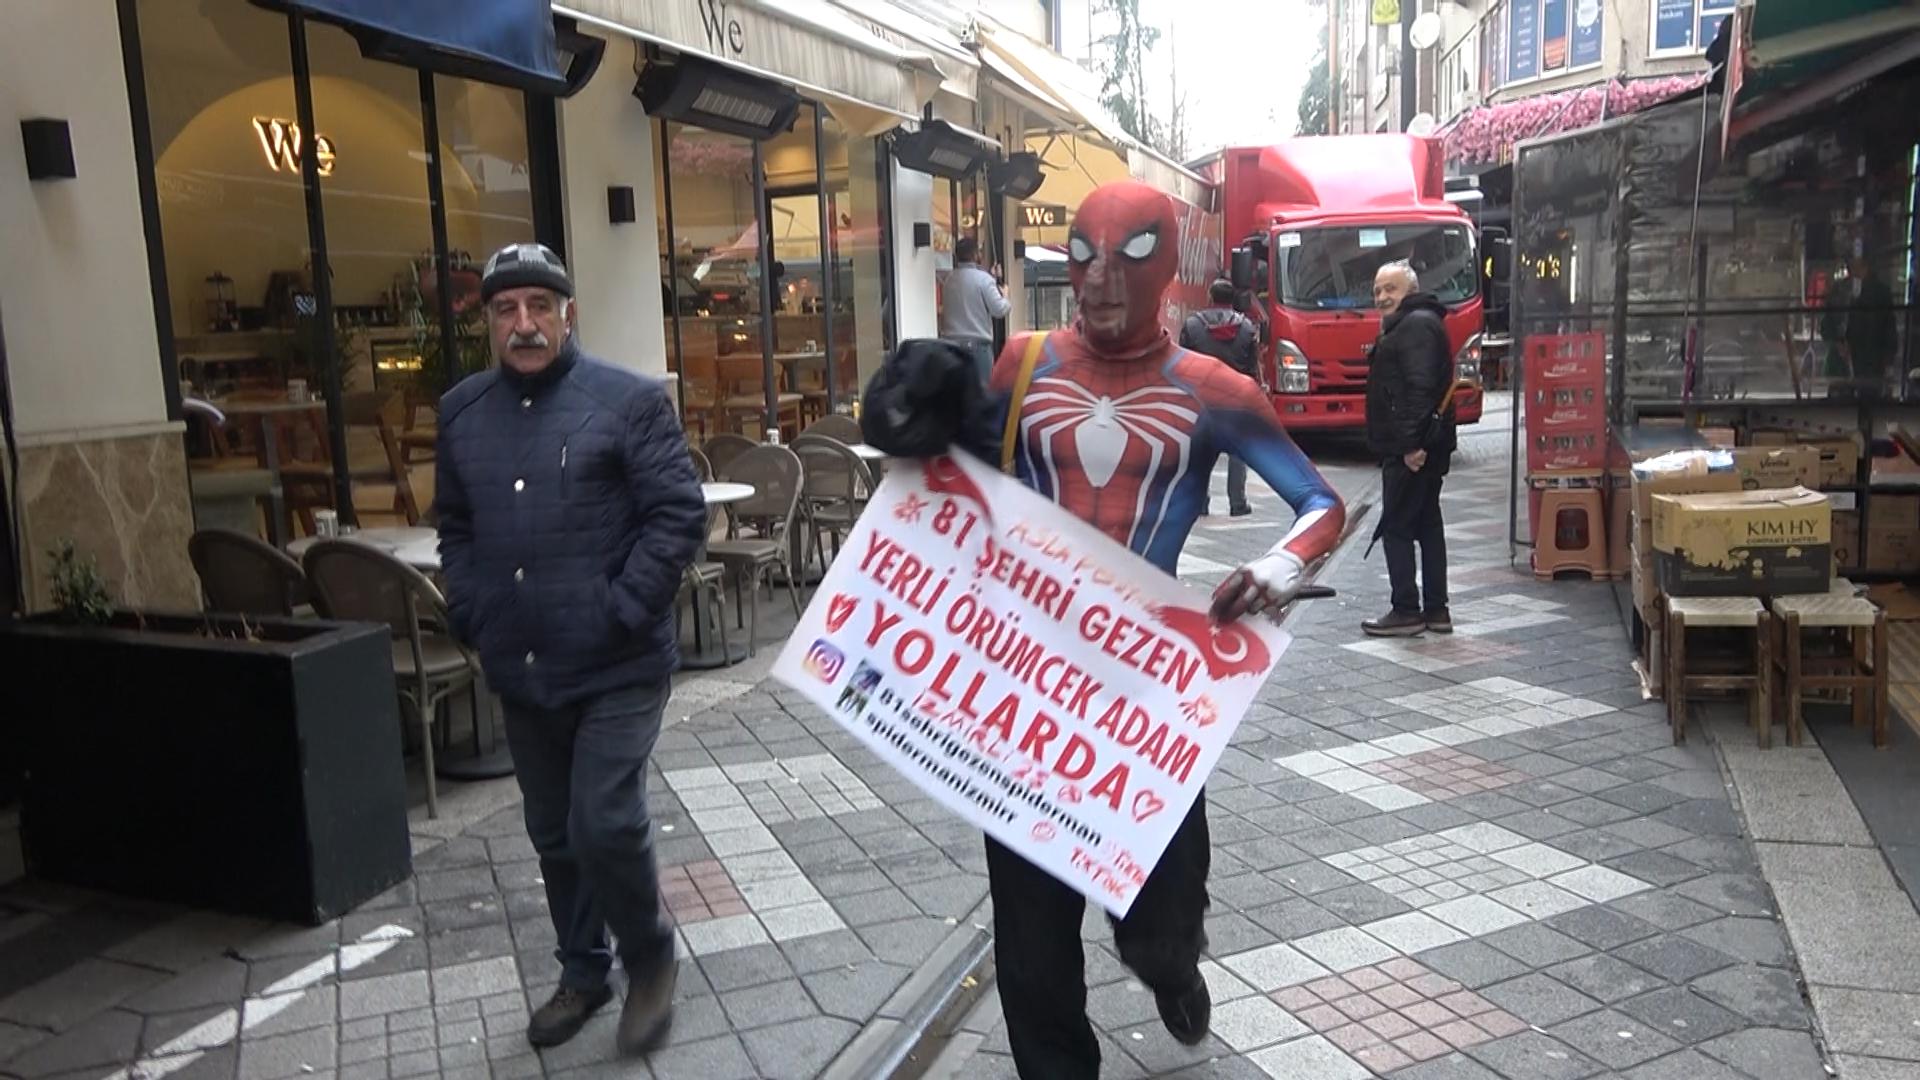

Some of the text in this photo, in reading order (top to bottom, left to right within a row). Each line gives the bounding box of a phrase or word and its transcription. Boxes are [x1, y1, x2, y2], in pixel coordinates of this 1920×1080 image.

[699, 0, 744, 56] We
[252, 116, 337, 176] We
[1025, 207, 1055, 225] We
[1748, 519, 1818, 536] KIM HY
[932, 497, 977, 549] 81
[975, 534, 1081, 622] ŞEHRİ
[1079, 603, 1202, 694] GEZEN
[859, 530, 956, 616] YERLİ
[946, 582, 1105, 721] ÖRÜMCEK
[1094, 694, 1201, 785] ADAM
[865, 599, 1131, 812] YOLLARDA
[866, 711, 1019, 824] spidermanizmirr
